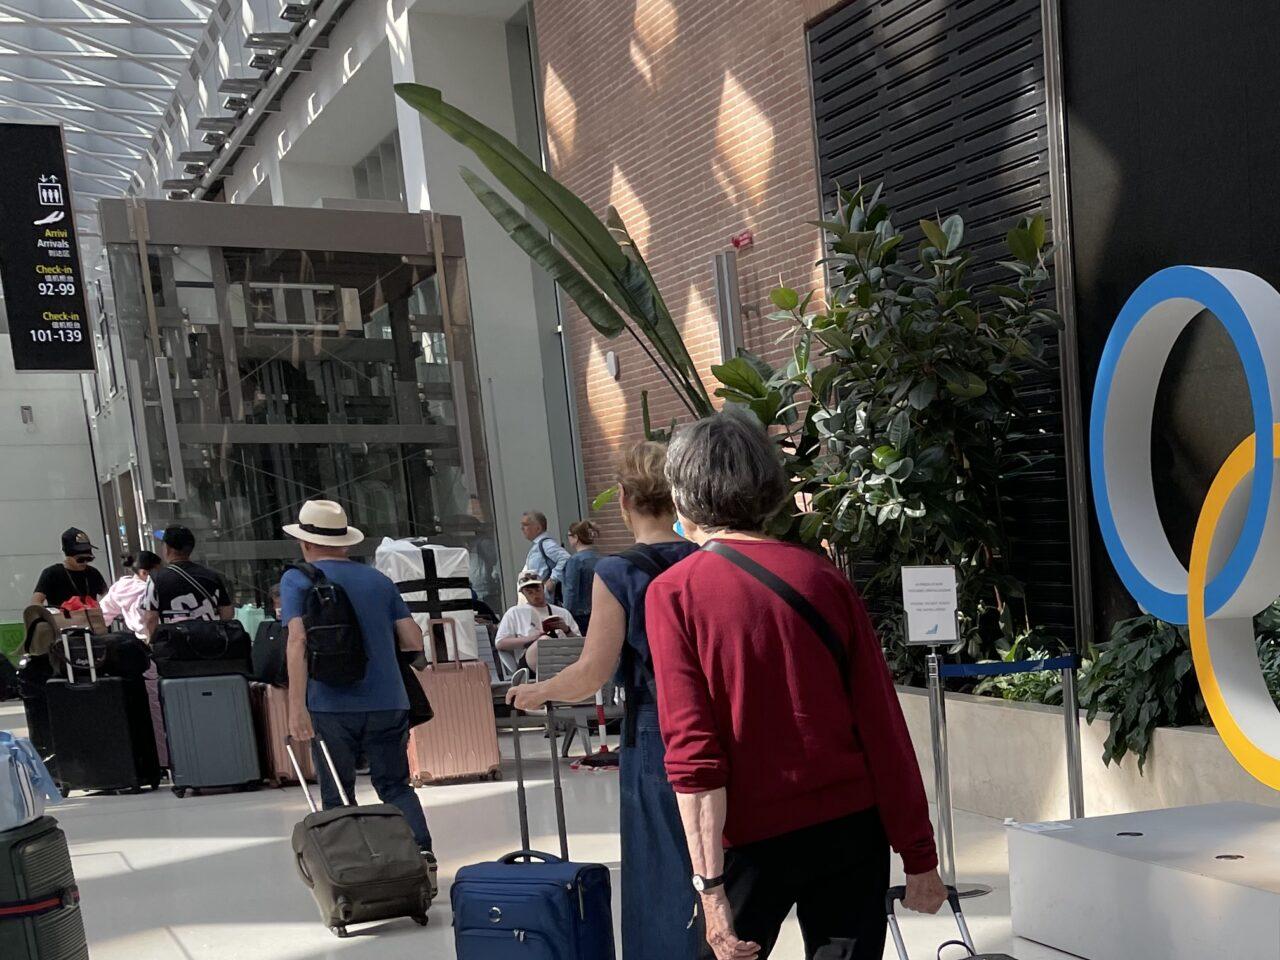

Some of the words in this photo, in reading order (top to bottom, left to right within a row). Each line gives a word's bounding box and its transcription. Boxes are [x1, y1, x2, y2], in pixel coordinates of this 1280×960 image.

[45, 229, 67, 238] Arrivi
[37, 239, 70, 248] Arrivals
[35, 265, 73, 274] Check-in
[38, 283, 76, 295] 92-99
[42, 312, 80, 321] Check-in
[30, 330, 82, 342] 101-139
